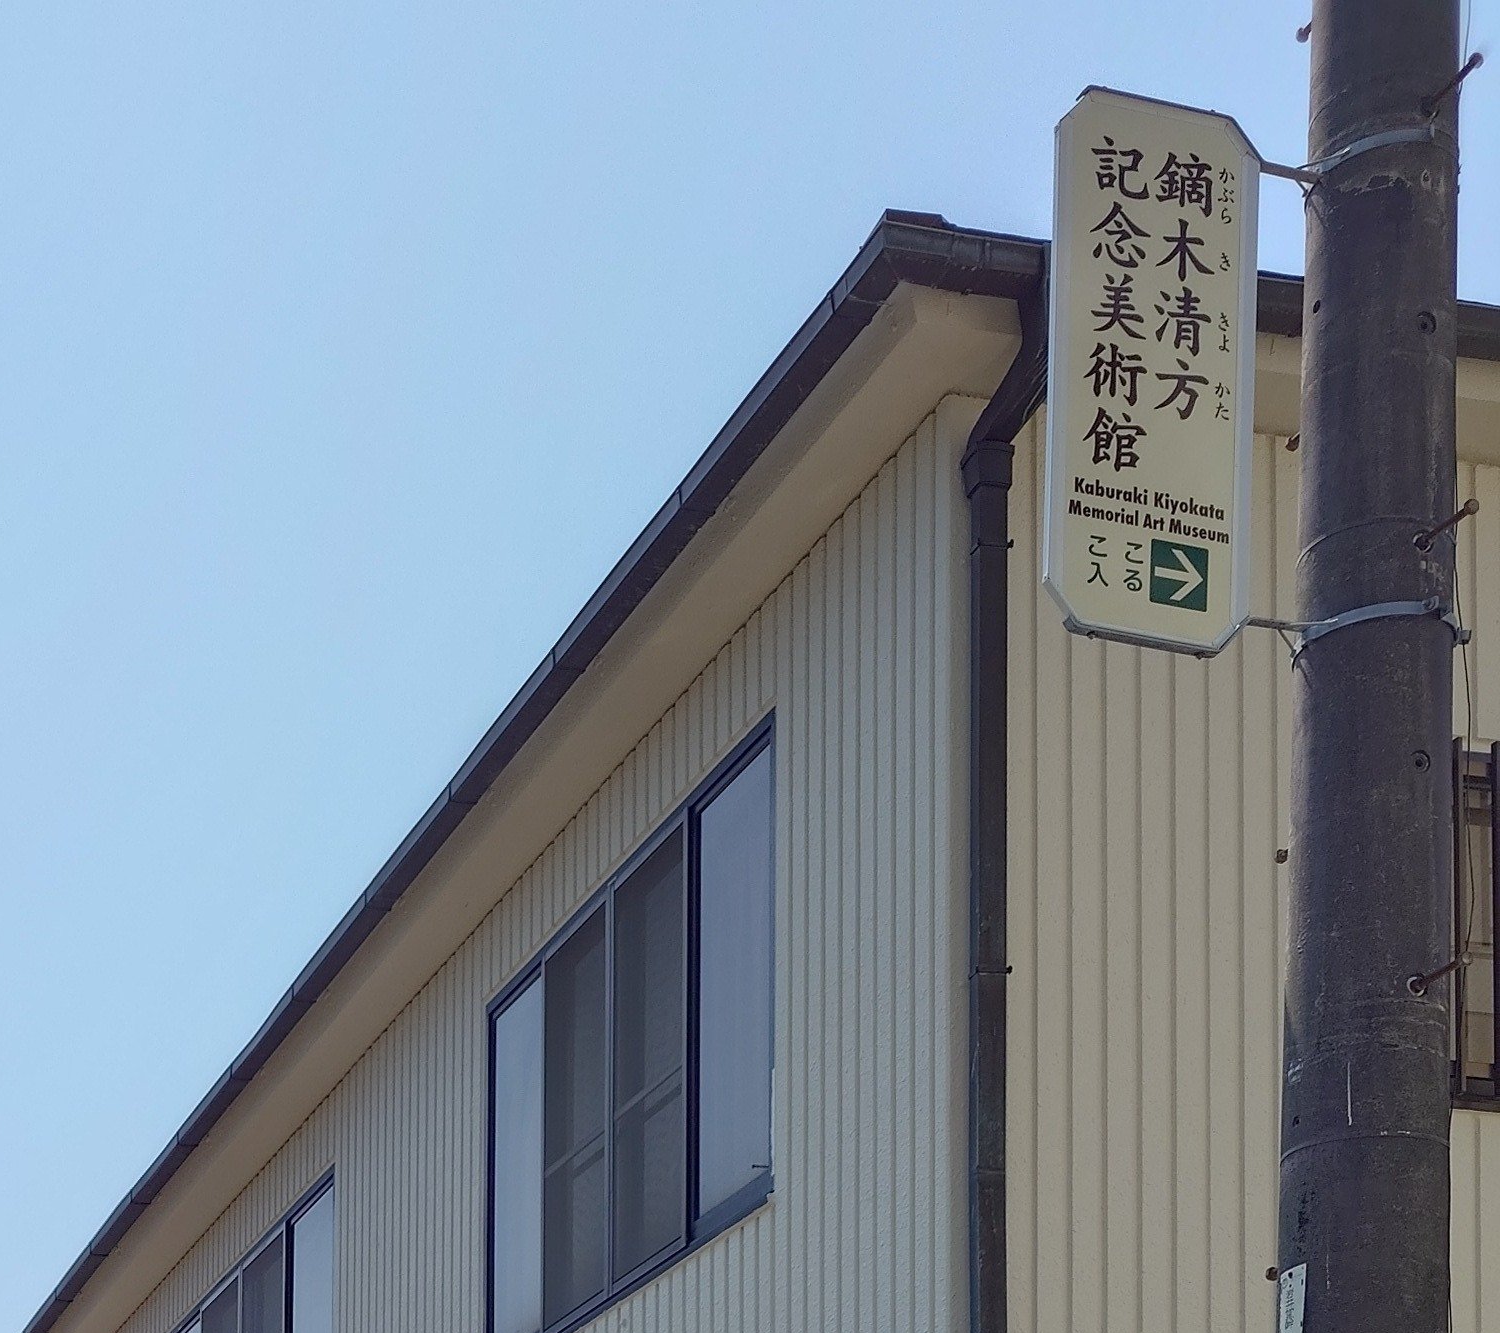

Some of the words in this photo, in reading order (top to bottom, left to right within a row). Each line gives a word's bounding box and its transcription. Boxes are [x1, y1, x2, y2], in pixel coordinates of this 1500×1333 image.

[1082, 135, 1152, 472] 記念美術館
[1153, 152, 1215, 420] 鏑木清方
[1068, 499, 1139, 527] Memorial
[1143, 513, 1165, 532] Art
[1168, 518, 1230, 544] Museum
[1074, 476, 1148, 506] Kaburaki
[1153, 491, 1225, 521] Kiyokata
